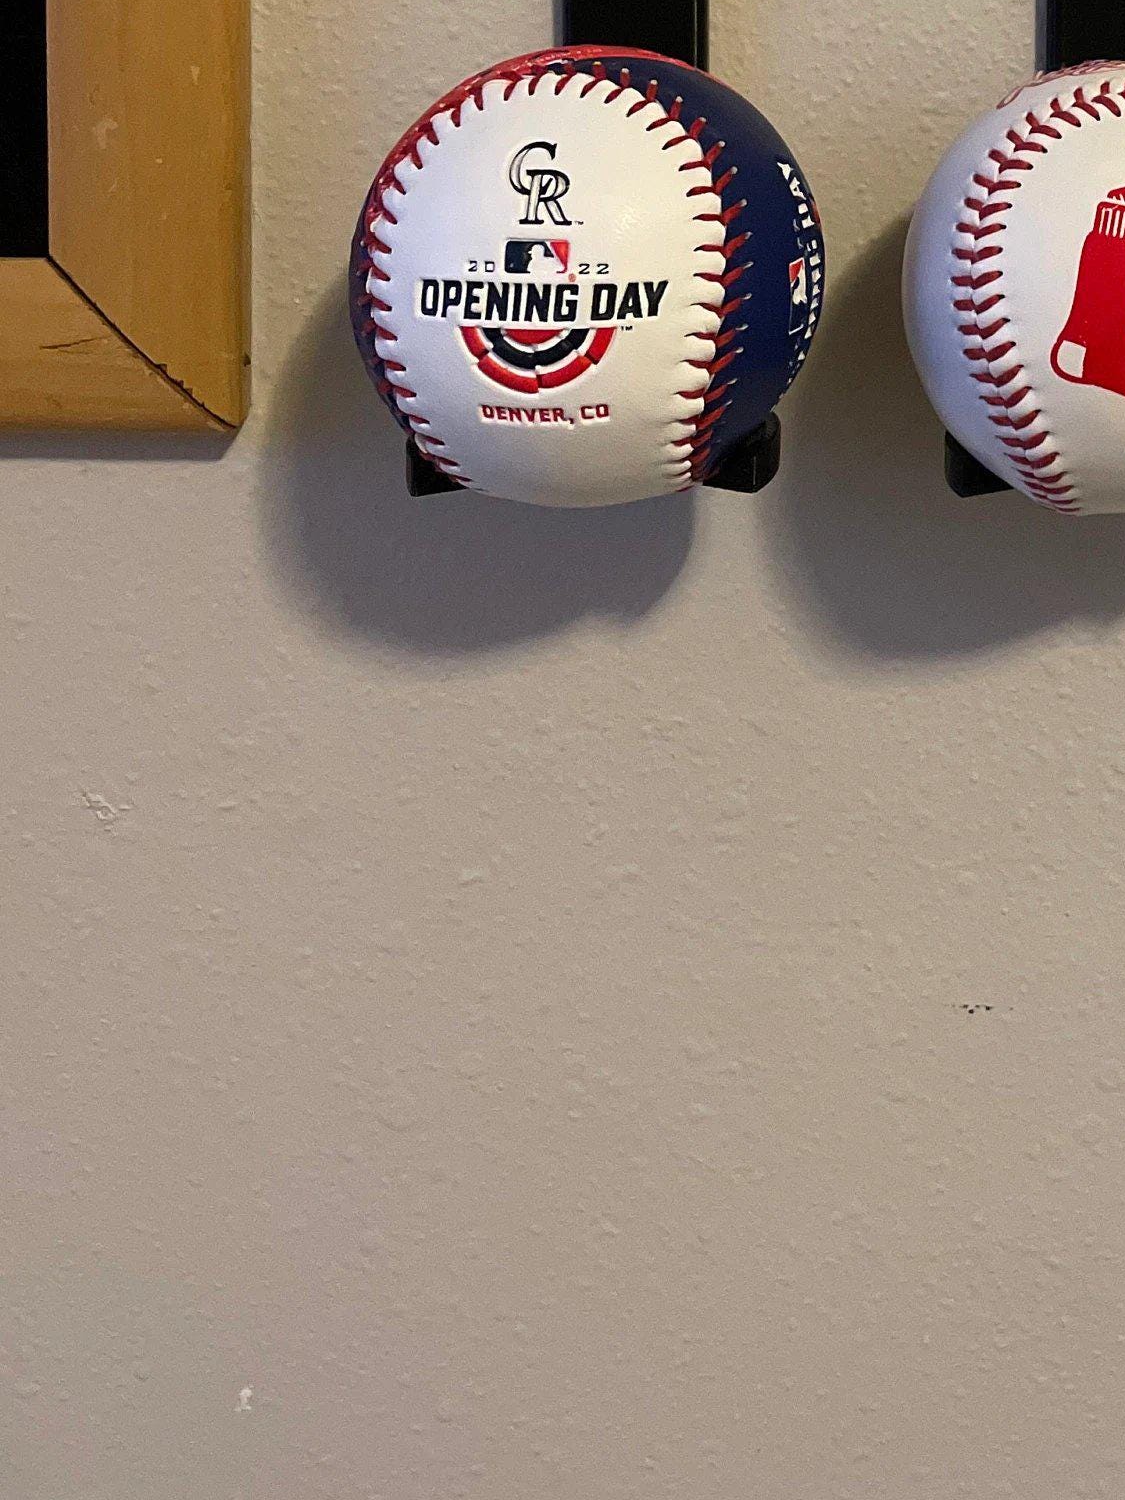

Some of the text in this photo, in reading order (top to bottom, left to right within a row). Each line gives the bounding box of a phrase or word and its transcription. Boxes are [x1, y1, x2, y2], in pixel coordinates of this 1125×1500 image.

[420, 279, 669, 322] OPENING DAY
[481, 404, 609, 425] DENVER, CO
